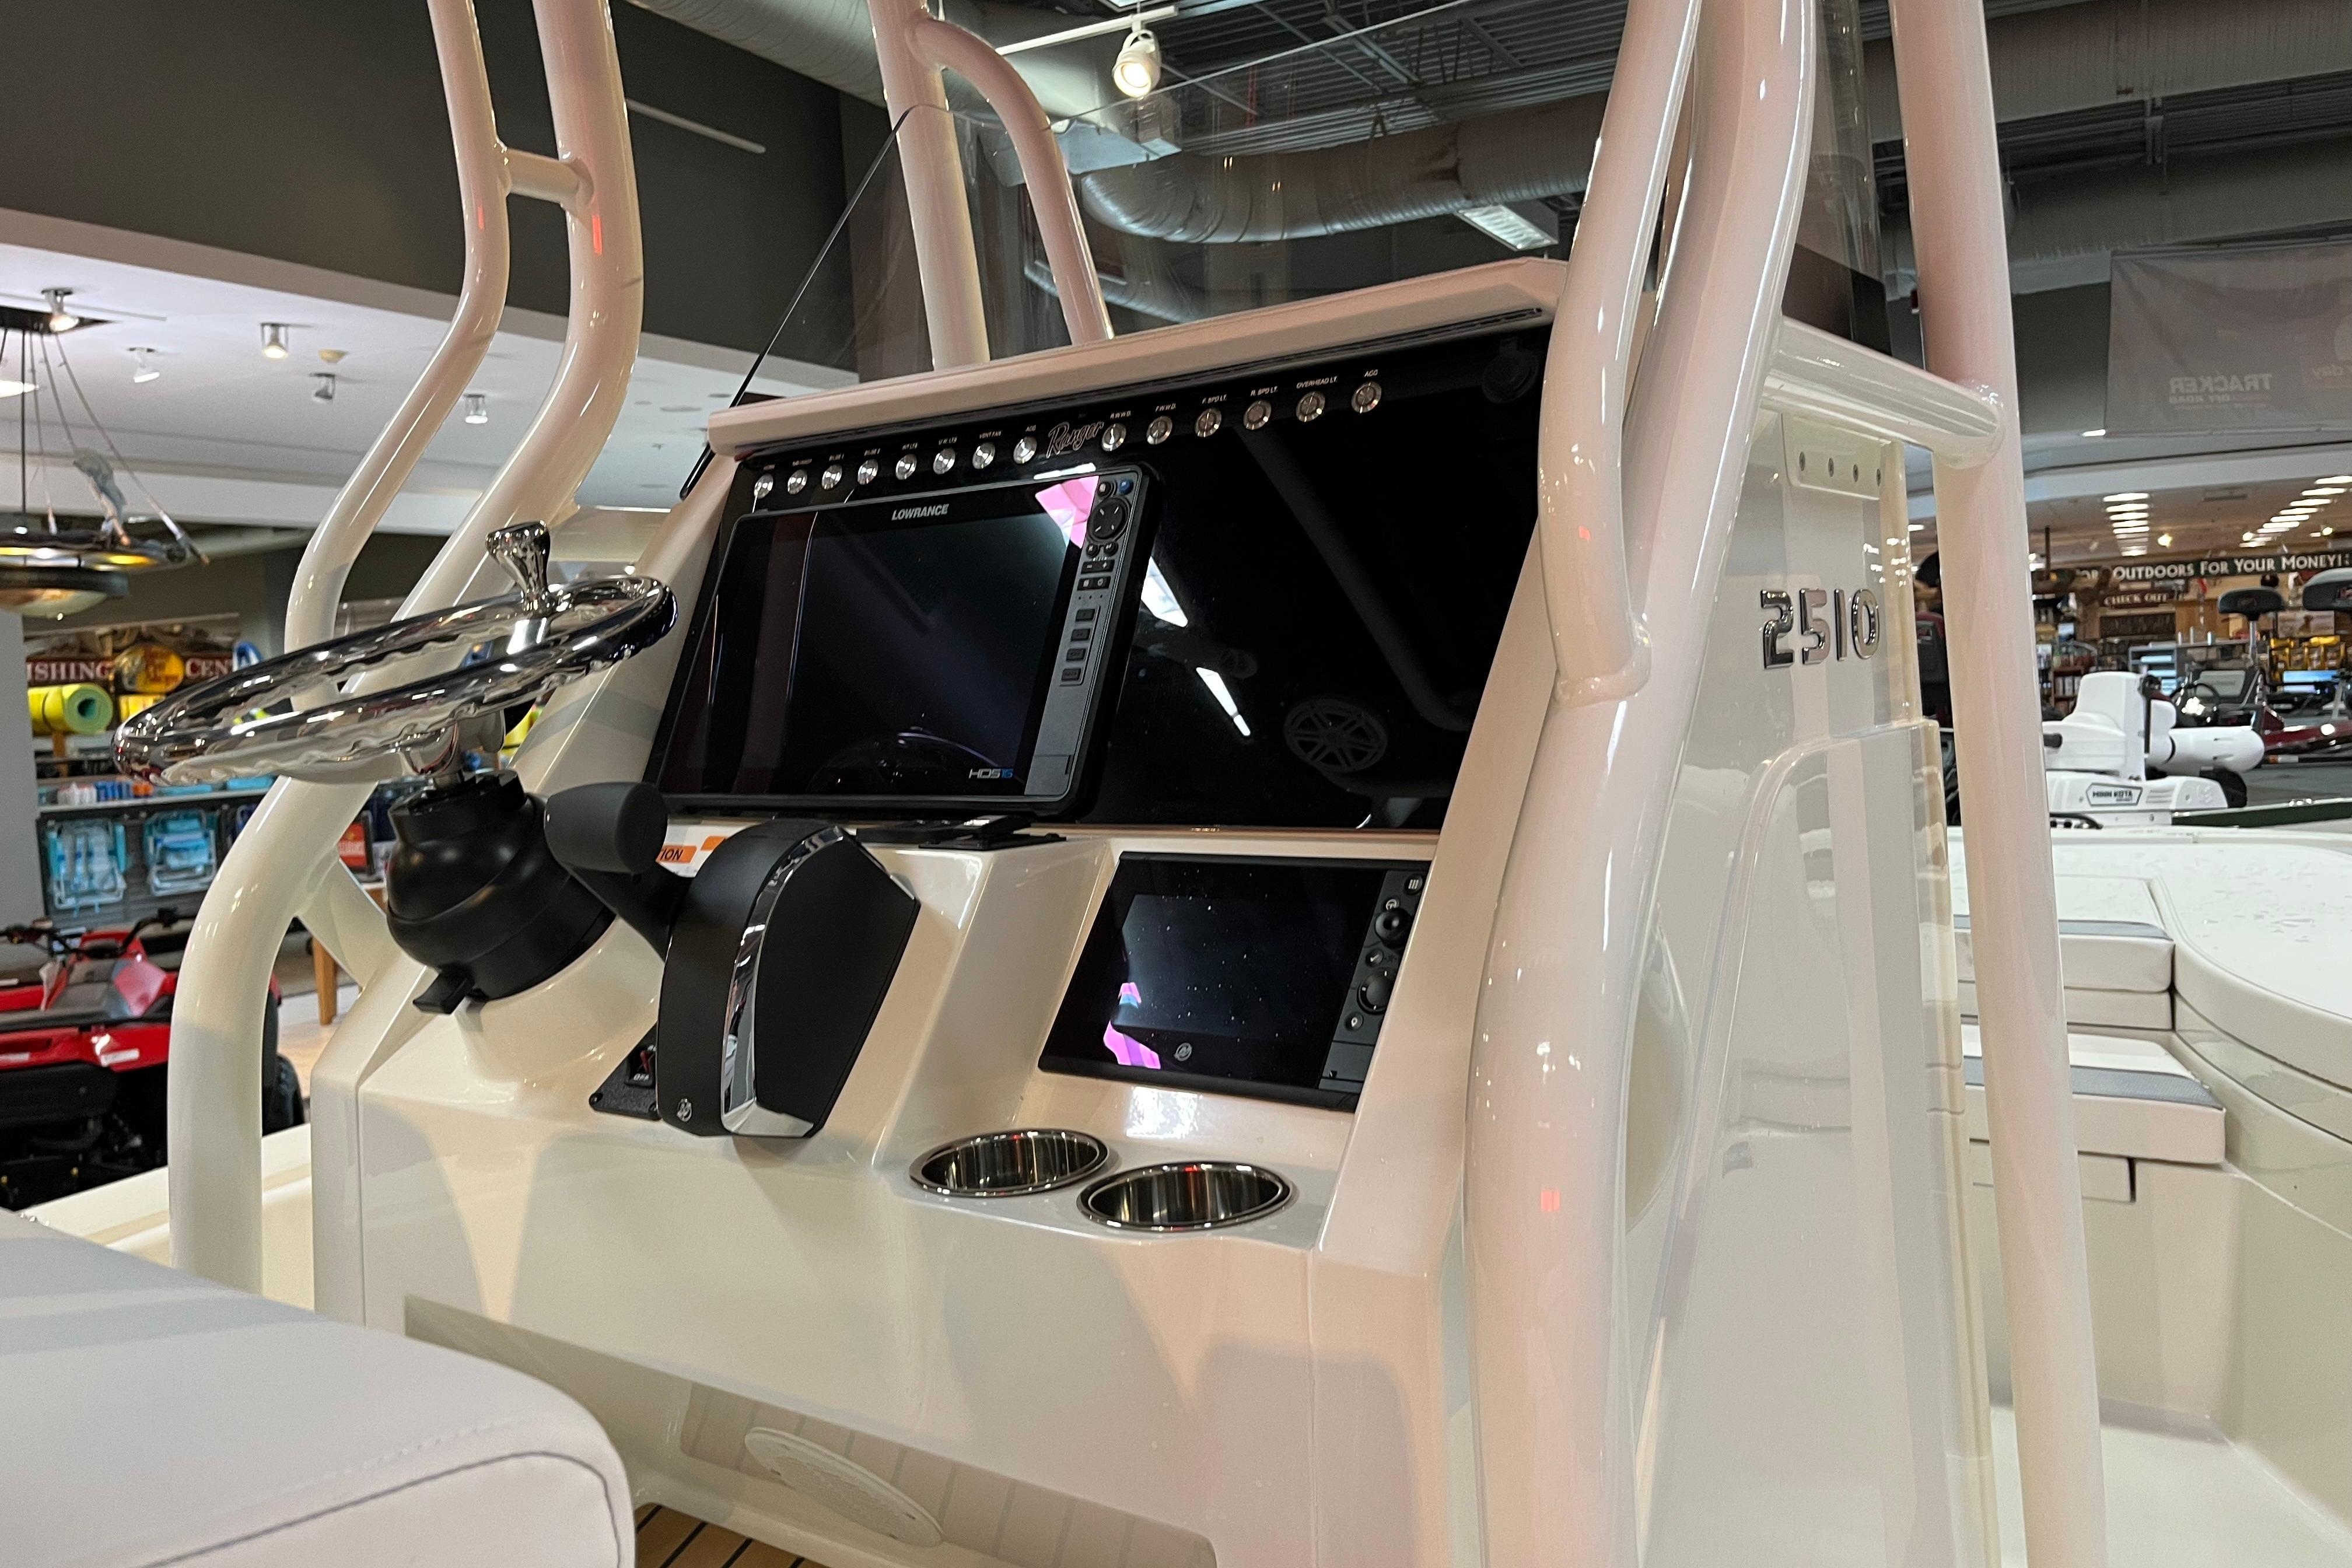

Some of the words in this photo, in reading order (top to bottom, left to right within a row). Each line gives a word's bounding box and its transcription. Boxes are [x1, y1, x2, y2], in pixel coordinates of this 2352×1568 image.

[1046, 421, 1104, 459] Ranger
[891, 503, 949, 521] LOWRANCE
[2113, 563, 2194, 580] OUTDOORS
[2200, 561, 2230, 575] FOR
[2234, 558, 2275, 573] YOUR
[1760, 587, 1880, 670] 2510
[26, 661, 112, 681] ISHING
[186, 657, 233, 679] CEN
